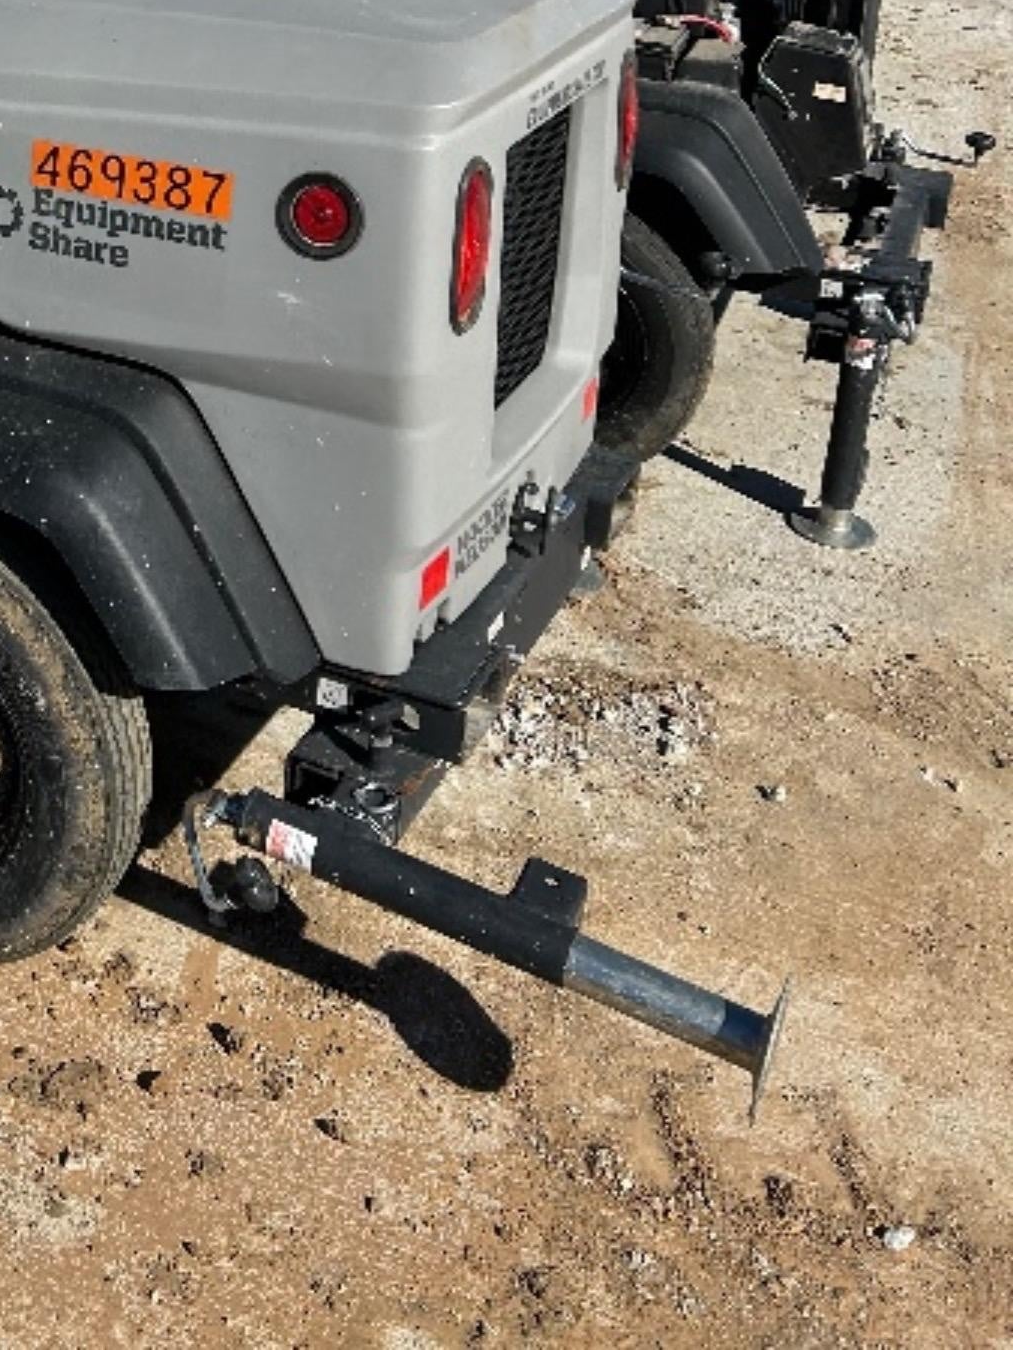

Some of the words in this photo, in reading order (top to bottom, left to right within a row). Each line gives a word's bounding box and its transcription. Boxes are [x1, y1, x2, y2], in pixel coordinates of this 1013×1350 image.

[35, 146, 227, 213] 469387
[29, 221, 128, 267] Share
[32, 186, 227, 251] Equipment
